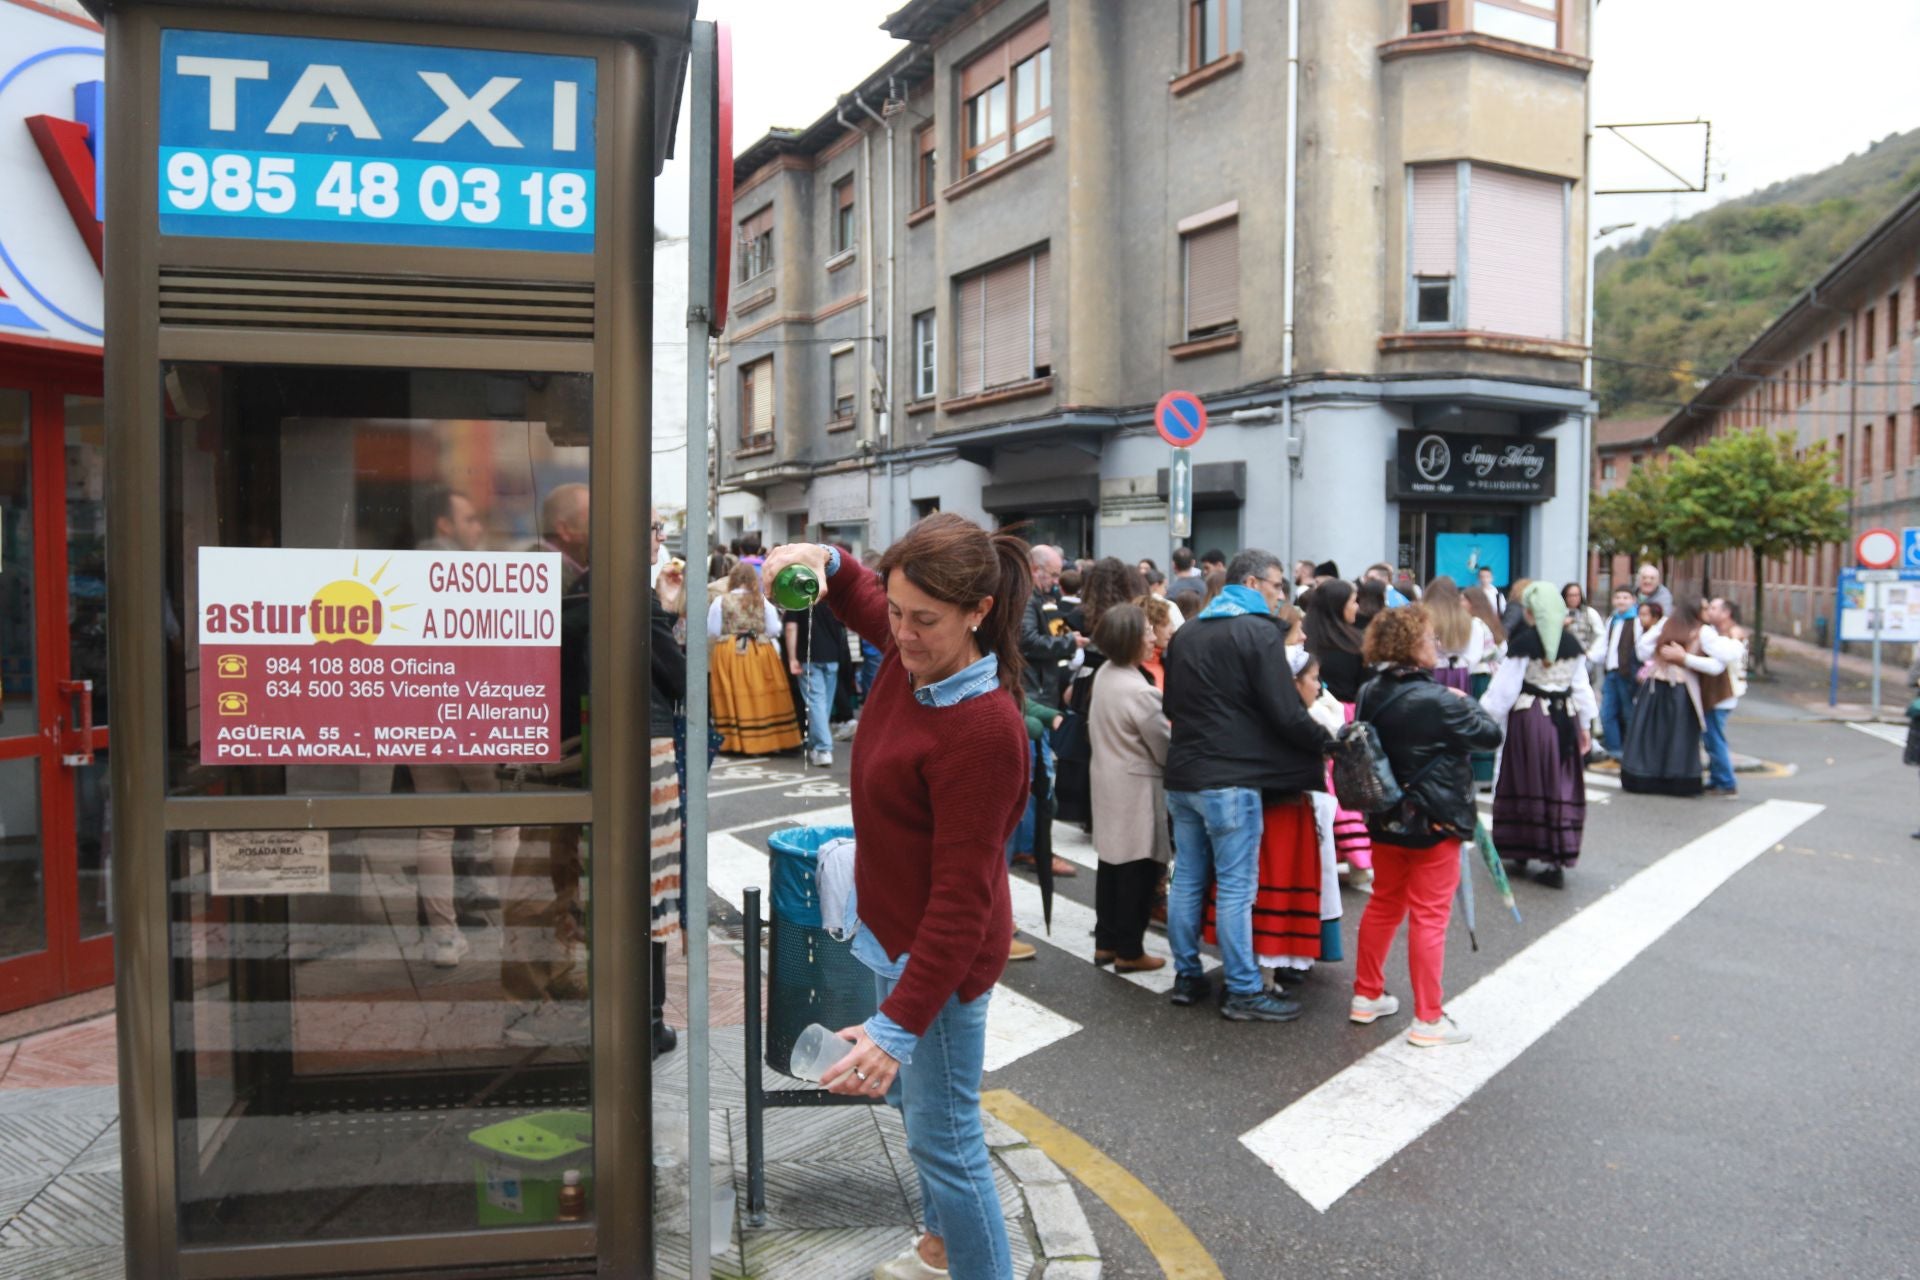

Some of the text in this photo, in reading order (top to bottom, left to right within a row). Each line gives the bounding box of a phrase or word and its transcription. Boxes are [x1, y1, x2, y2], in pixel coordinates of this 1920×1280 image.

[176, 55, 578, 151] TAXI
[167, 151, 588, 228] 985 48 03 18
[429, 562, 549, 593] GASOLEOS
[206, 599, 382, 635] asturfuel
[423, 608, 555, 640] A DOMICILIO
[266, 658, 456, 675] 984 108 808 Oficina
[266, 680, 546, 701] 634 500 365 Vicente Vázquez
[437, 703, 549, 722] (El Alleranu)
[217, 724, 305, 740] AGÜERIA
[319, 727, 340, 740] 55
[374, 727, 456, 739] MOREDA
[488, 727, 549, 739] ALLER
[218, 744, 262, 757] POL.
[268, 744, 292, 757] LA
[298, 744, 371, 759] MORAL,
[377, 744, 426, 756] NAVE
[432, 744, 442, 756] 4
[458, 743, 549, 756] LANGREO
[238, 846, 305, 857] POSADA REAL
